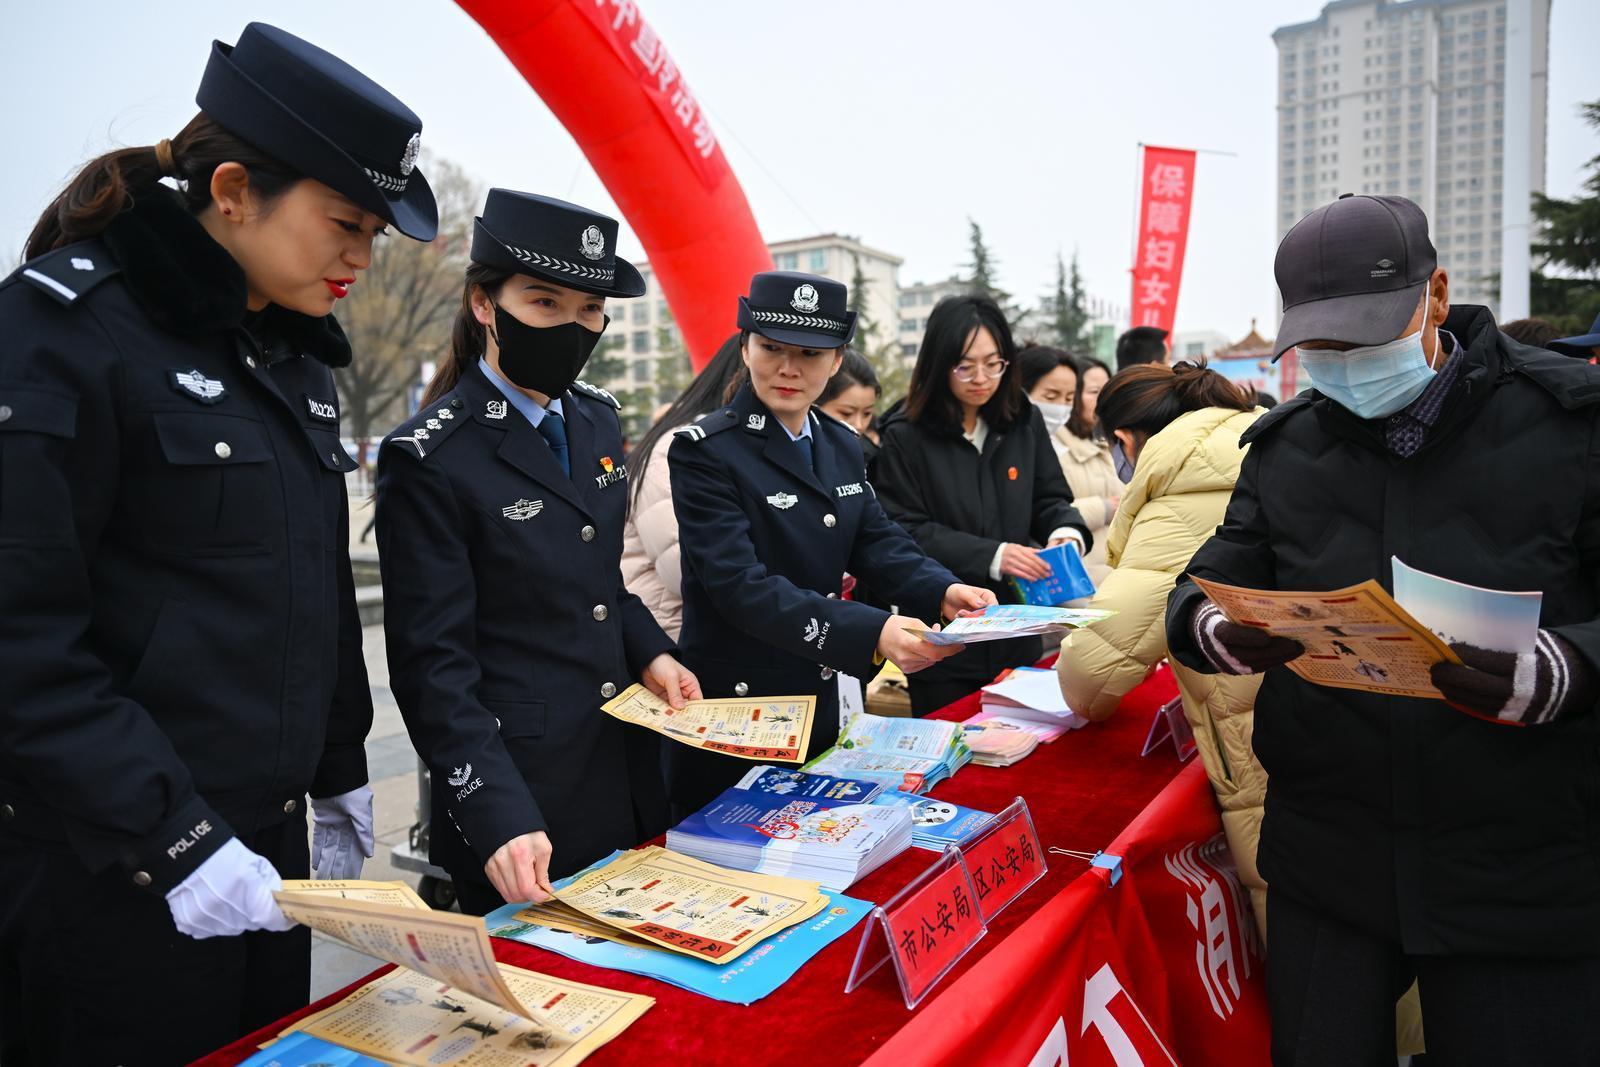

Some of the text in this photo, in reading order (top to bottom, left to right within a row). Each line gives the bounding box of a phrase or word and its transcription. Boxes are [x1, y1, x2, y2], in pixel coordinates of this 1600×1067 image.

[816, 620, 831, 650] POLICE
[456, 776, 485, 803] POLICE
[166, 819, 213, 860] POLICE
[972, 833, 1036, 901] 区公安局
[900, 885, 971, 971] 市公安局
